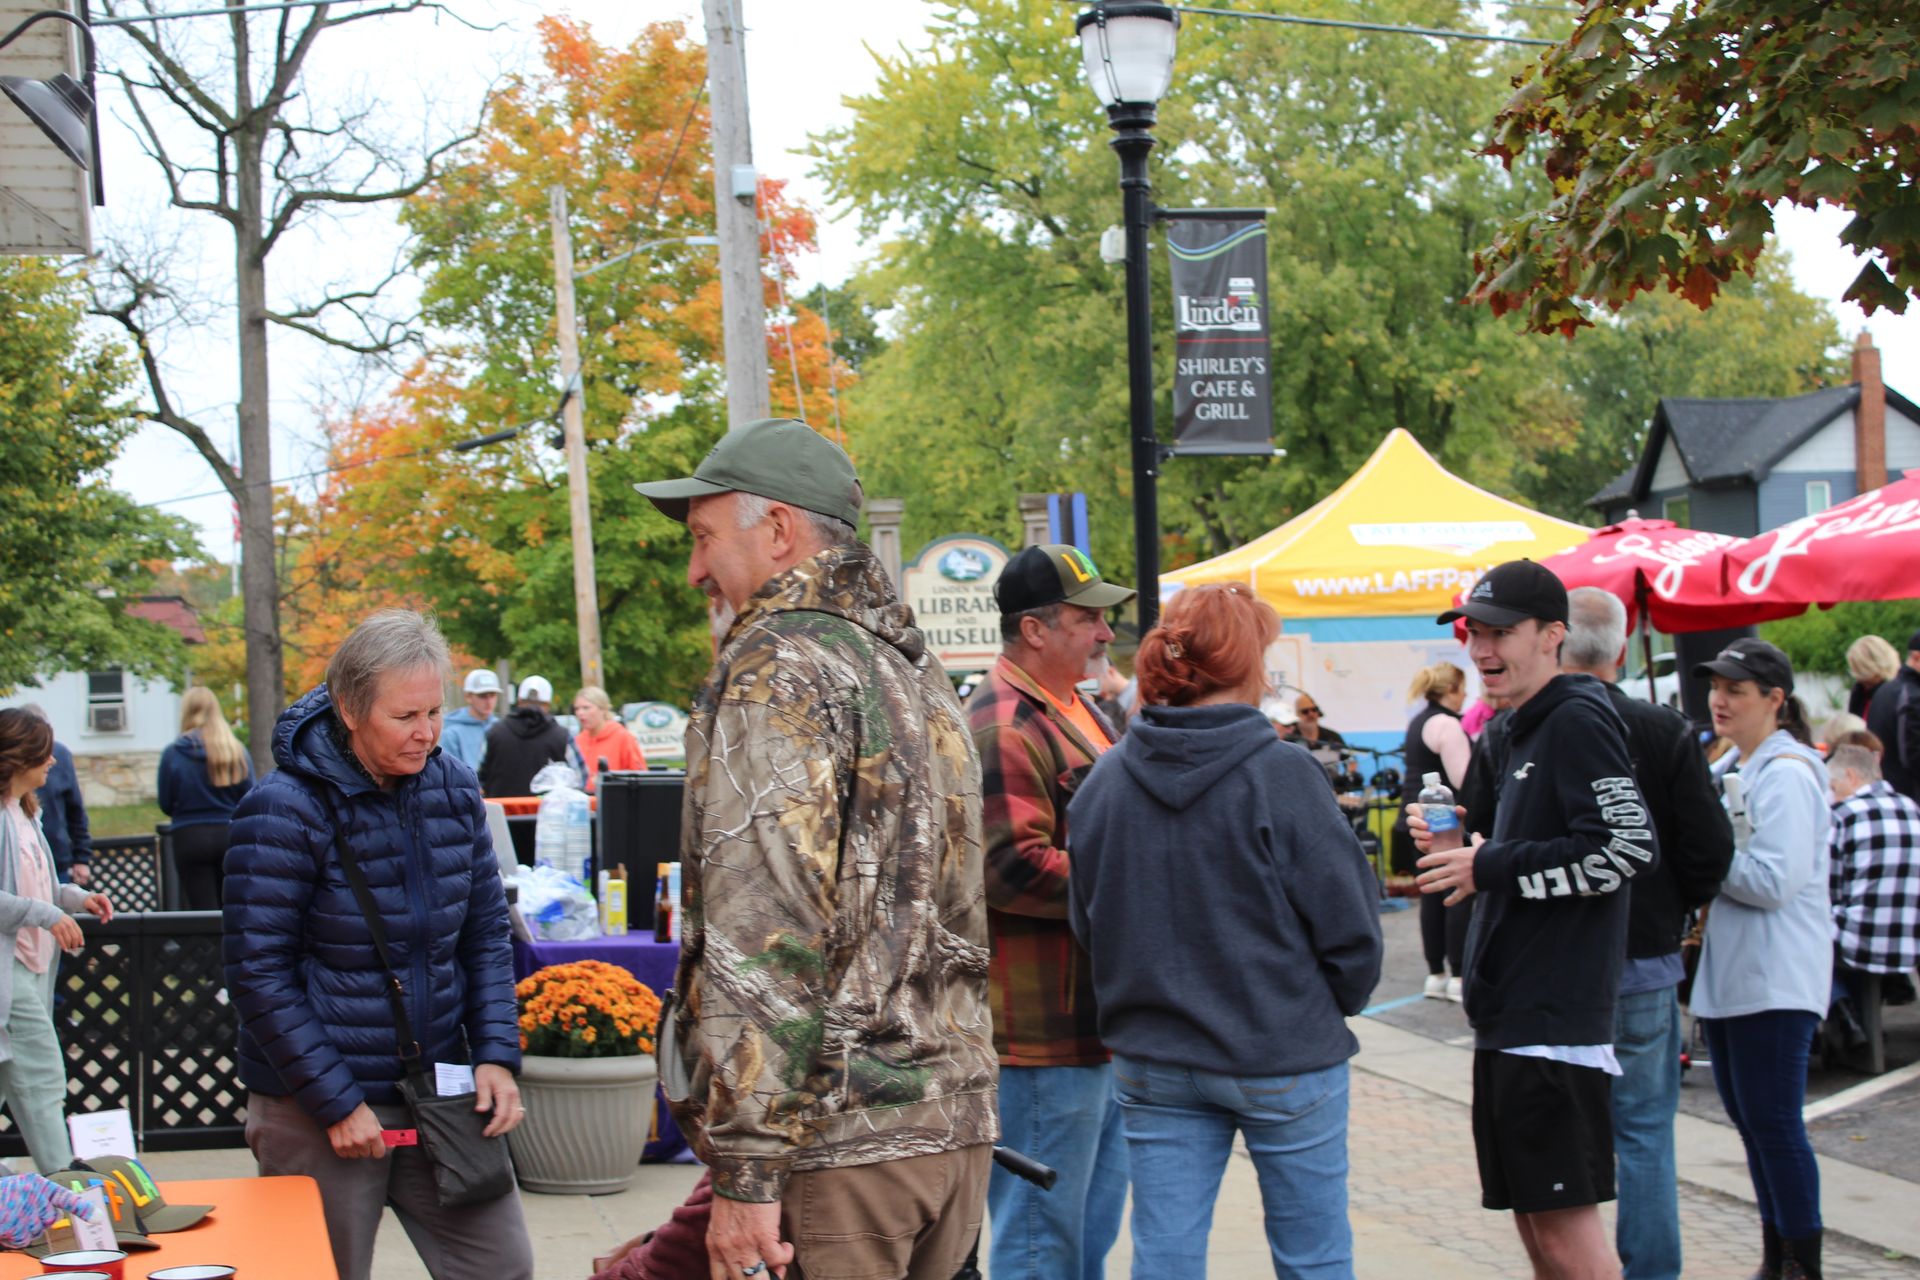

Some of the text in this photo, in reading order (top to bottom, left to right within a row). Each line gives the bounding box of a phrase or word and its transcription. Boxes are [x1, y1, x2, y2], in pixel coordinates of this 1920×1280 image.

[1179, 294, 1260, 326] Linden
[1178, 356, 1266, 376] SHIRLEY'S
[1190, 380, 1256, 398] CAFE &
[1195, 403, 1250, 420] GRILL
[1293, 565, 1493, 596] www.LAFFPat
[918, 597, 999, 615] LIBRAR
[923, 627, 998, 646] MUSEU
[112, 1160, 160, 1207] LA
